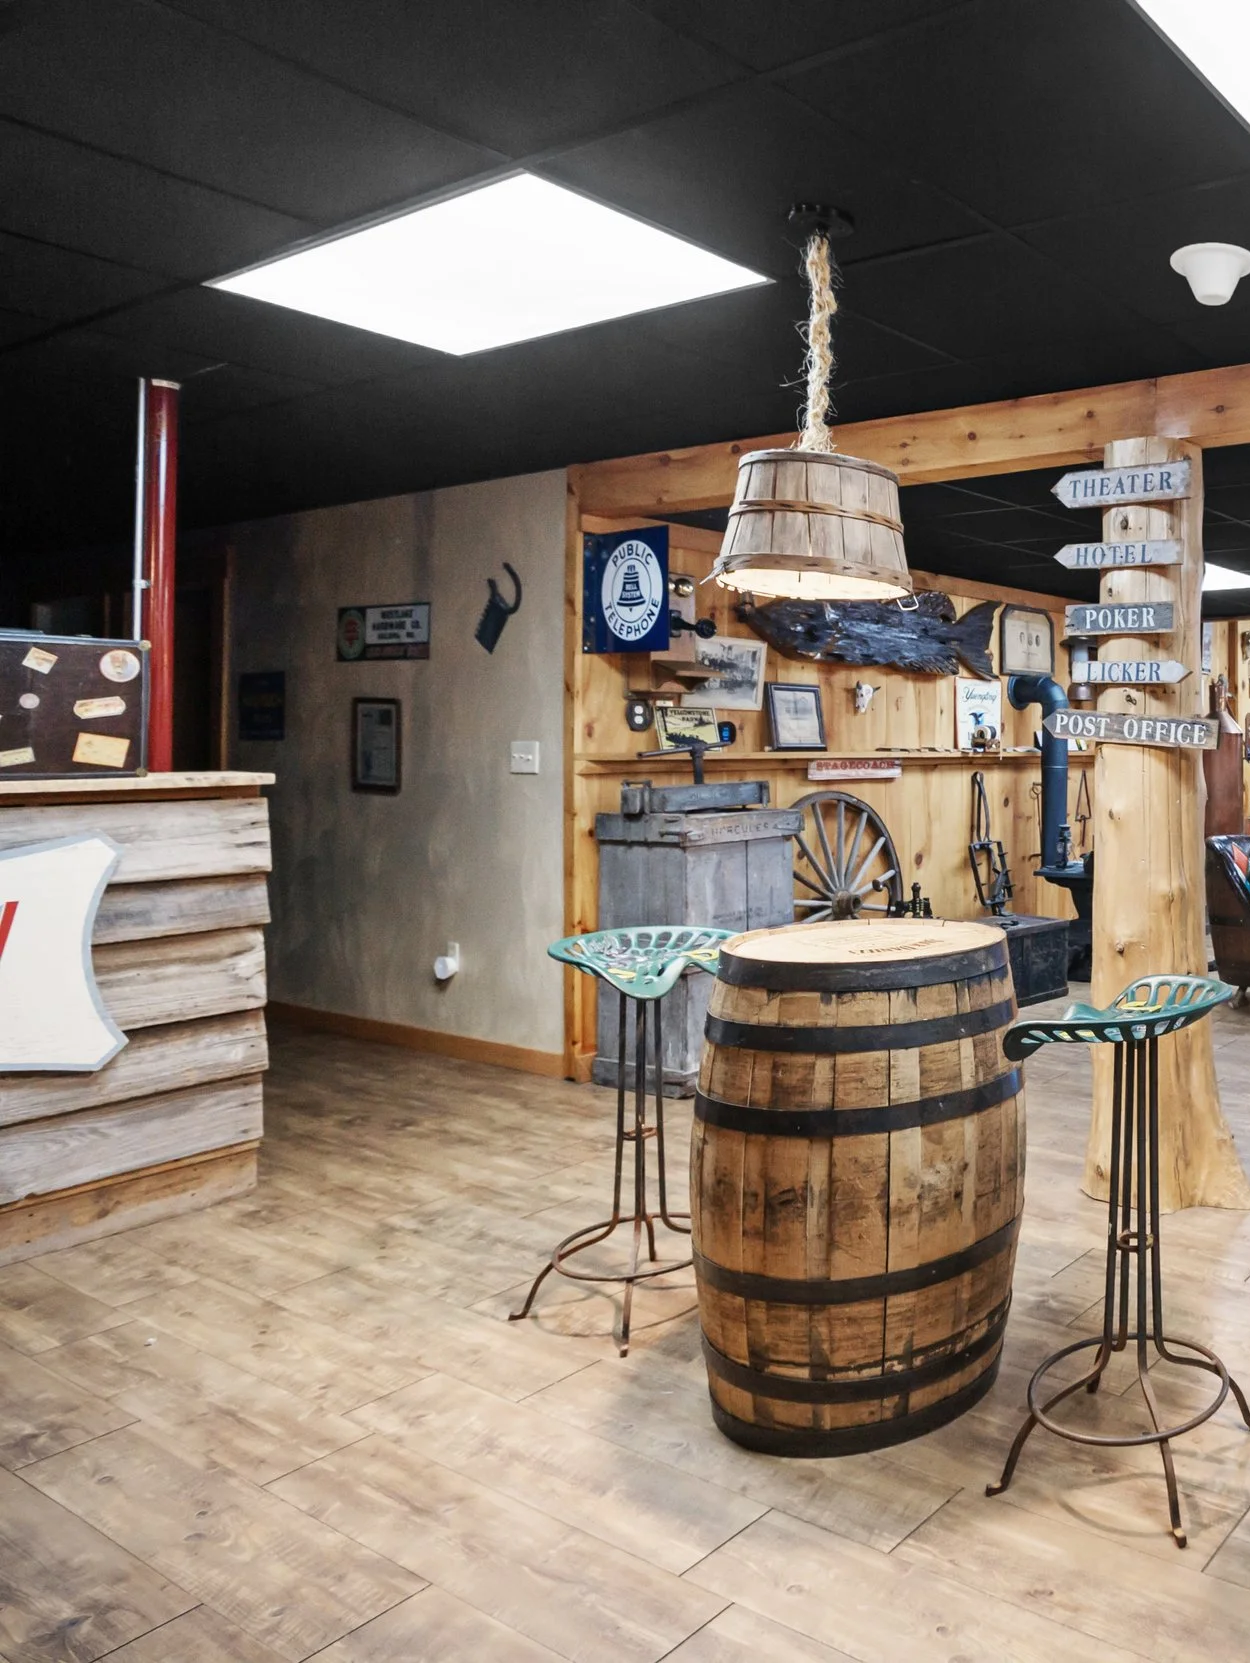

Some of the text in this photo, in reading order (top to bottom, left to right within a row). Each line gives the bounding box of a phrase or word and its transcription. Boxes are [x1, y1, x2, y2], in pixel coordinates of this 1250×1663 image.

[1069, 471, 1173, 499] THEATER
[611, 543, 653, 567] PUBLIC
[1075, 544, 1153, 566] HOTEL
[605, 598, 660, 638] TELEPHONE
[1085, 607, 1156, 630] POKER
[1087, 662, 1161, 682] LICKER
[962, 686, 998, 703] Yuengling
[669, 709, 710, 717] YELLOWSTONE
[1055, 713, 1207, 745] POST OFFICE
[816, 761, 895, 771] STAGECOACH
